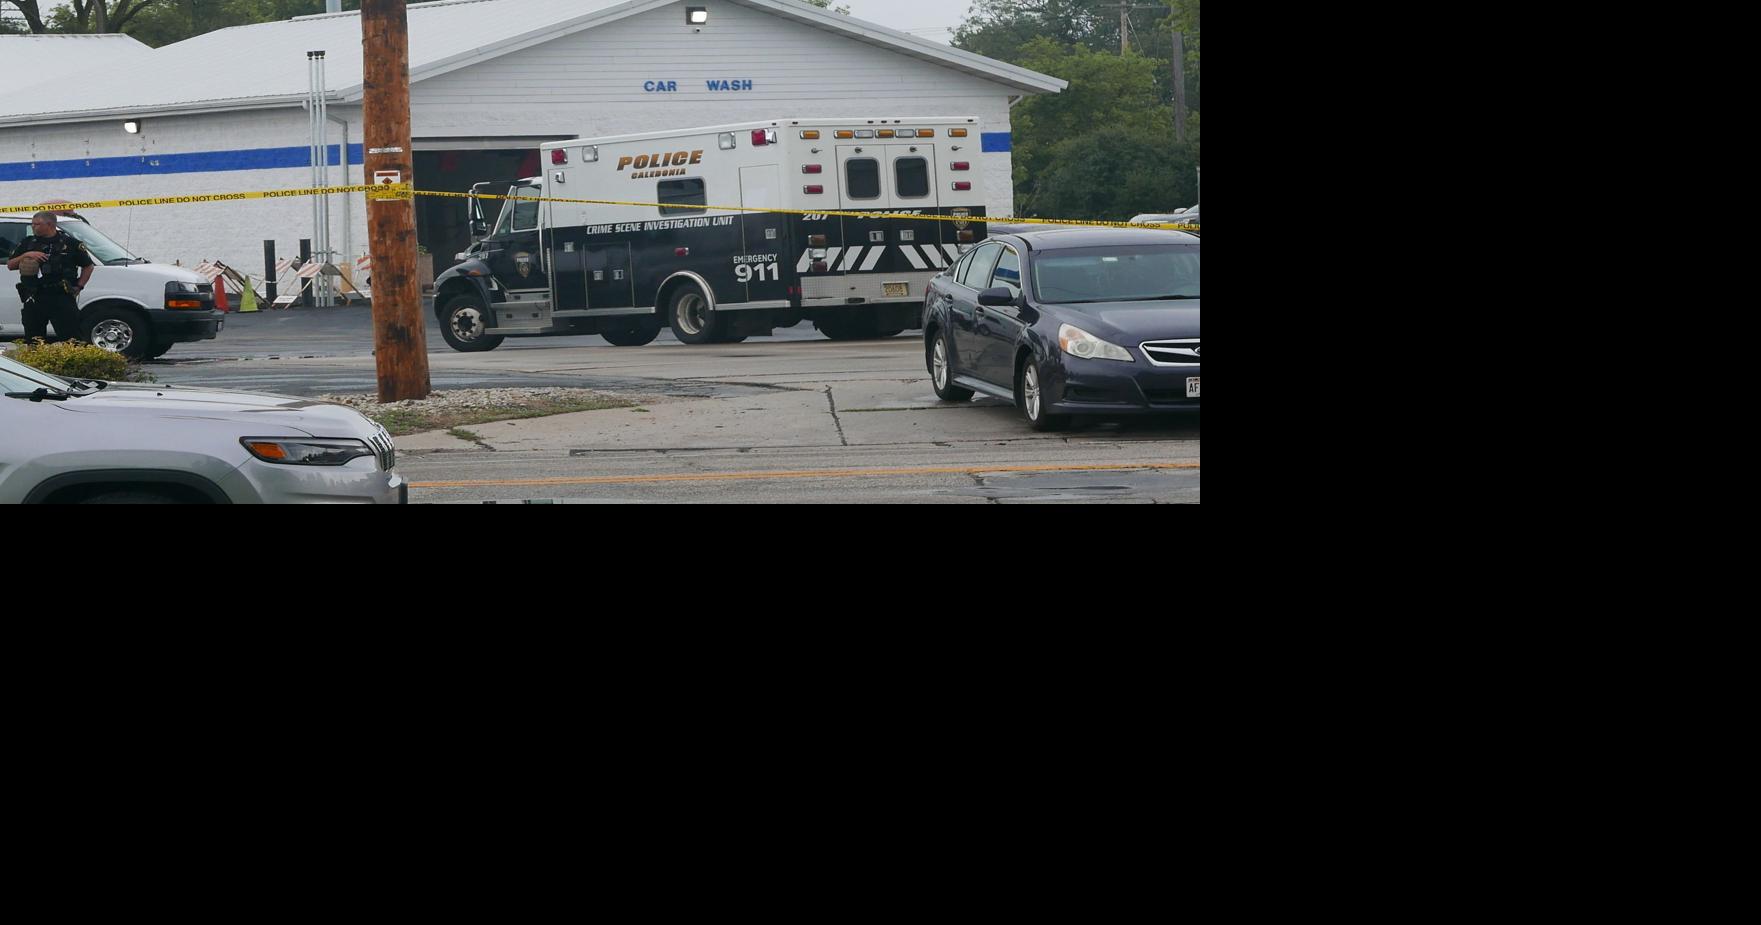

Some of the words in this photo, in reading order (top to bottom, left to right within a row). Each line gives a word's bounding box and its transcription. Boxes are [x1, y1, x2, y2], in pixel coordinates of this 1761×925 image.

[644, 81, 677, 91] CAR
[706, 80, 752, 90] WASH
[616, 150, 704, 171] POLICE
[631, 168, 686, 179] CALEDONIA
[263, 190, 296, 198] POLICE
[300, 188, 320, 196] LINE
[321, 187, 335, 195] DO
[336, 186, 355, 194] NOT
[119, 198, 153, 207] POLICE
[154, 197, 175, 205] LINE
[176, 196, 191, 204] DO
[192, 195, 210, 203] NOT
[213, 193, 246, 201] CROSS
[586, 224, 613, 235] CRIME
[614, 222, 641, 233] SCENE
[644, 218, 710, 231] INVESTIGATION
[712, 215, 734, 226] UNIT
[733, 253, 778, 264] EMERGENCY
[734, 262, 779, 282] 911
